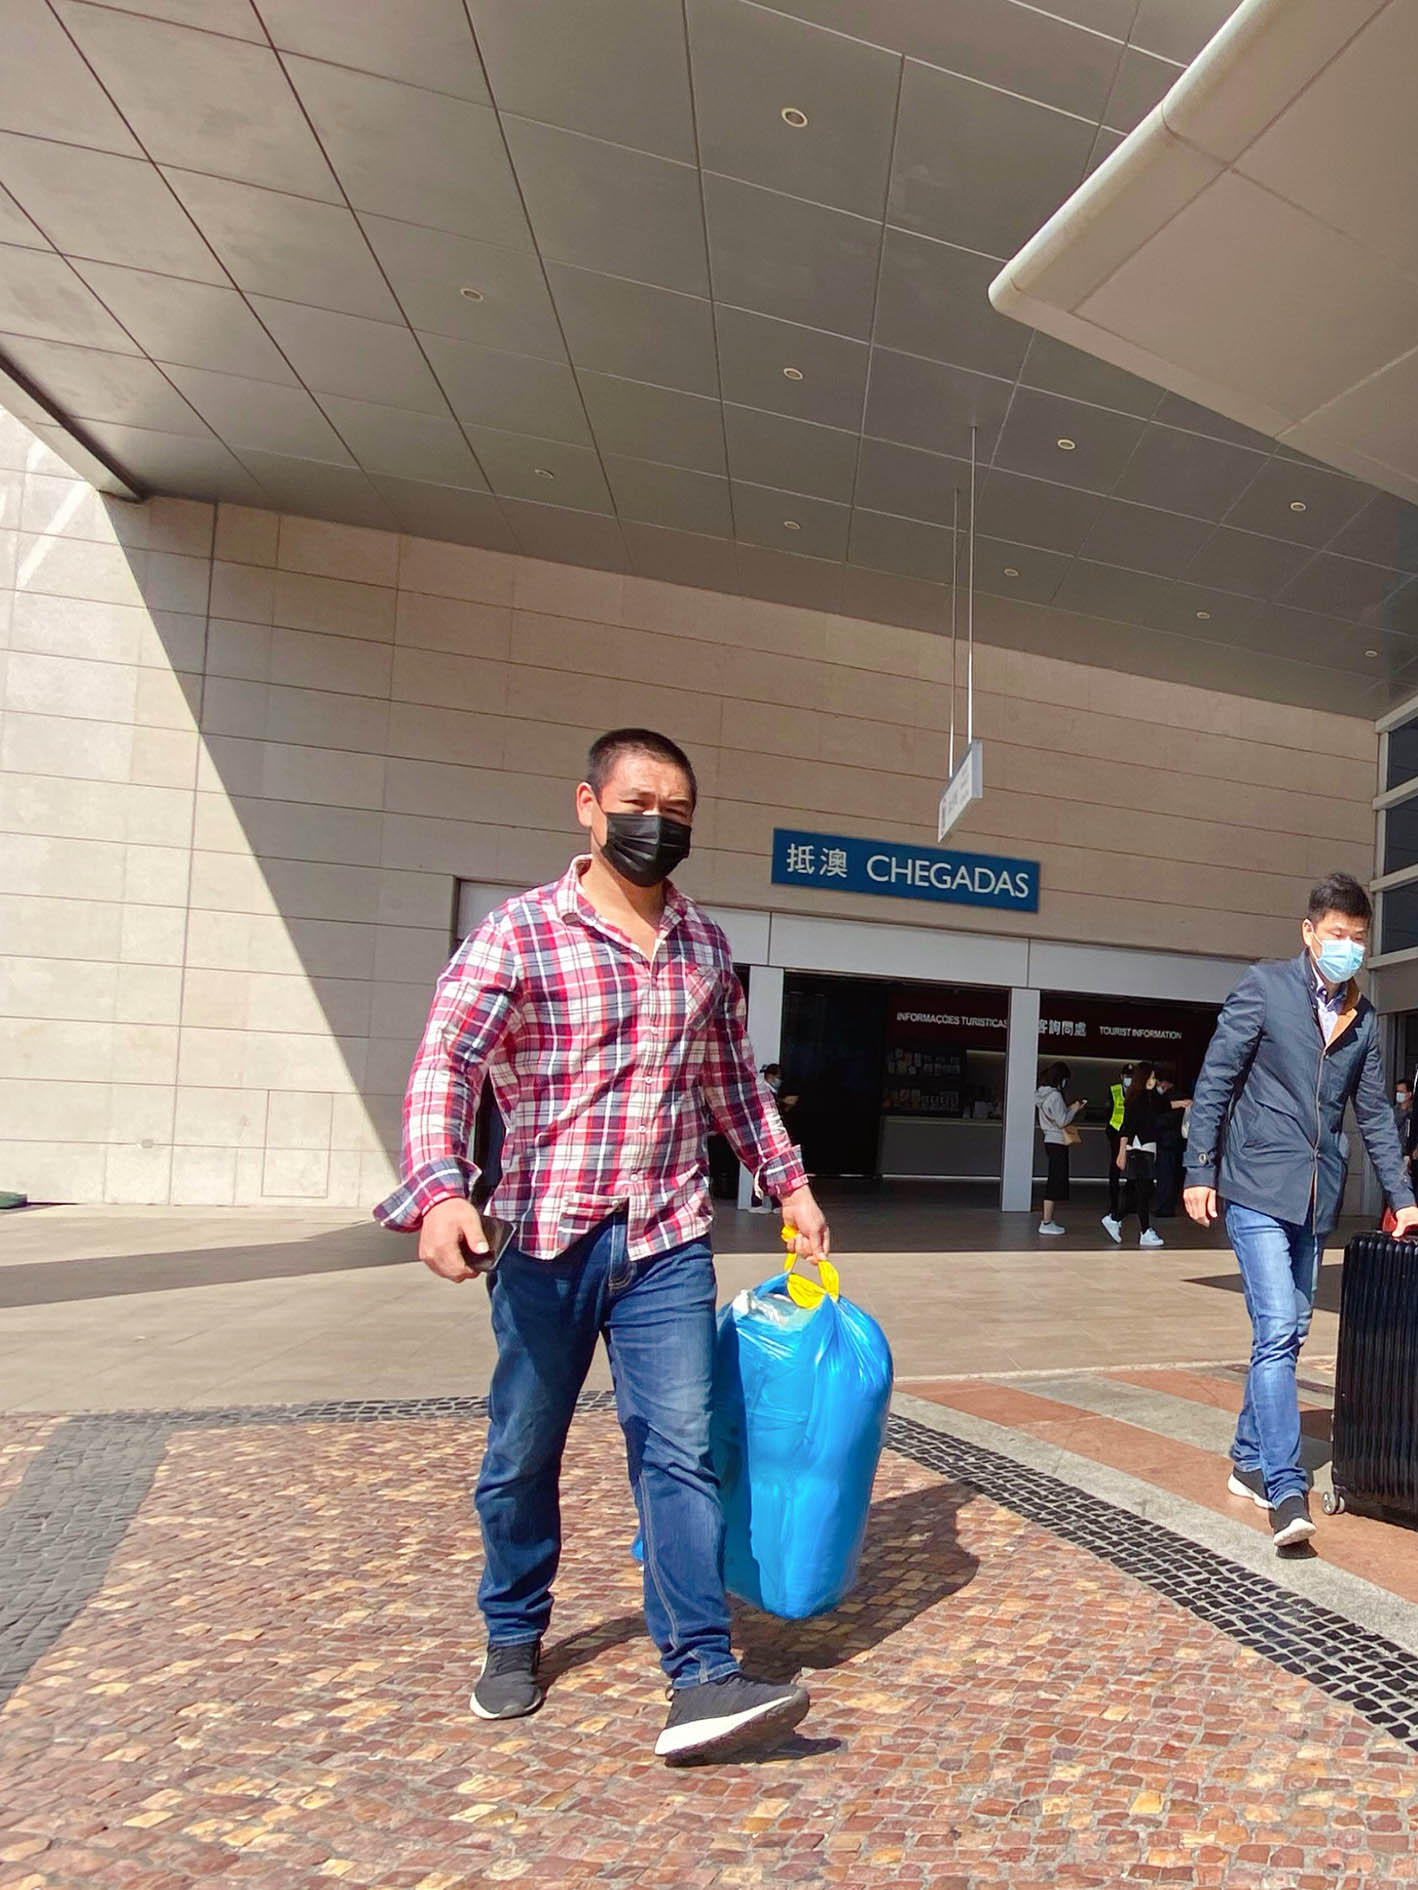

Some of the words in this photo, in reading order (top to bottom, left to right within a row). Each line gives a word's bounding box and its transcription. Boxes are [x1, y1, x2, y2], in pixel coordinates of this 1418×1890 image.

[786, 843, 848, 878] 抵澳
[866, 855, 1029, 898] CHEGADAS
[1099, 1026, 1131, 1037] TOURIST
[1131, 1029, 1182, 1040] INFORMATION
